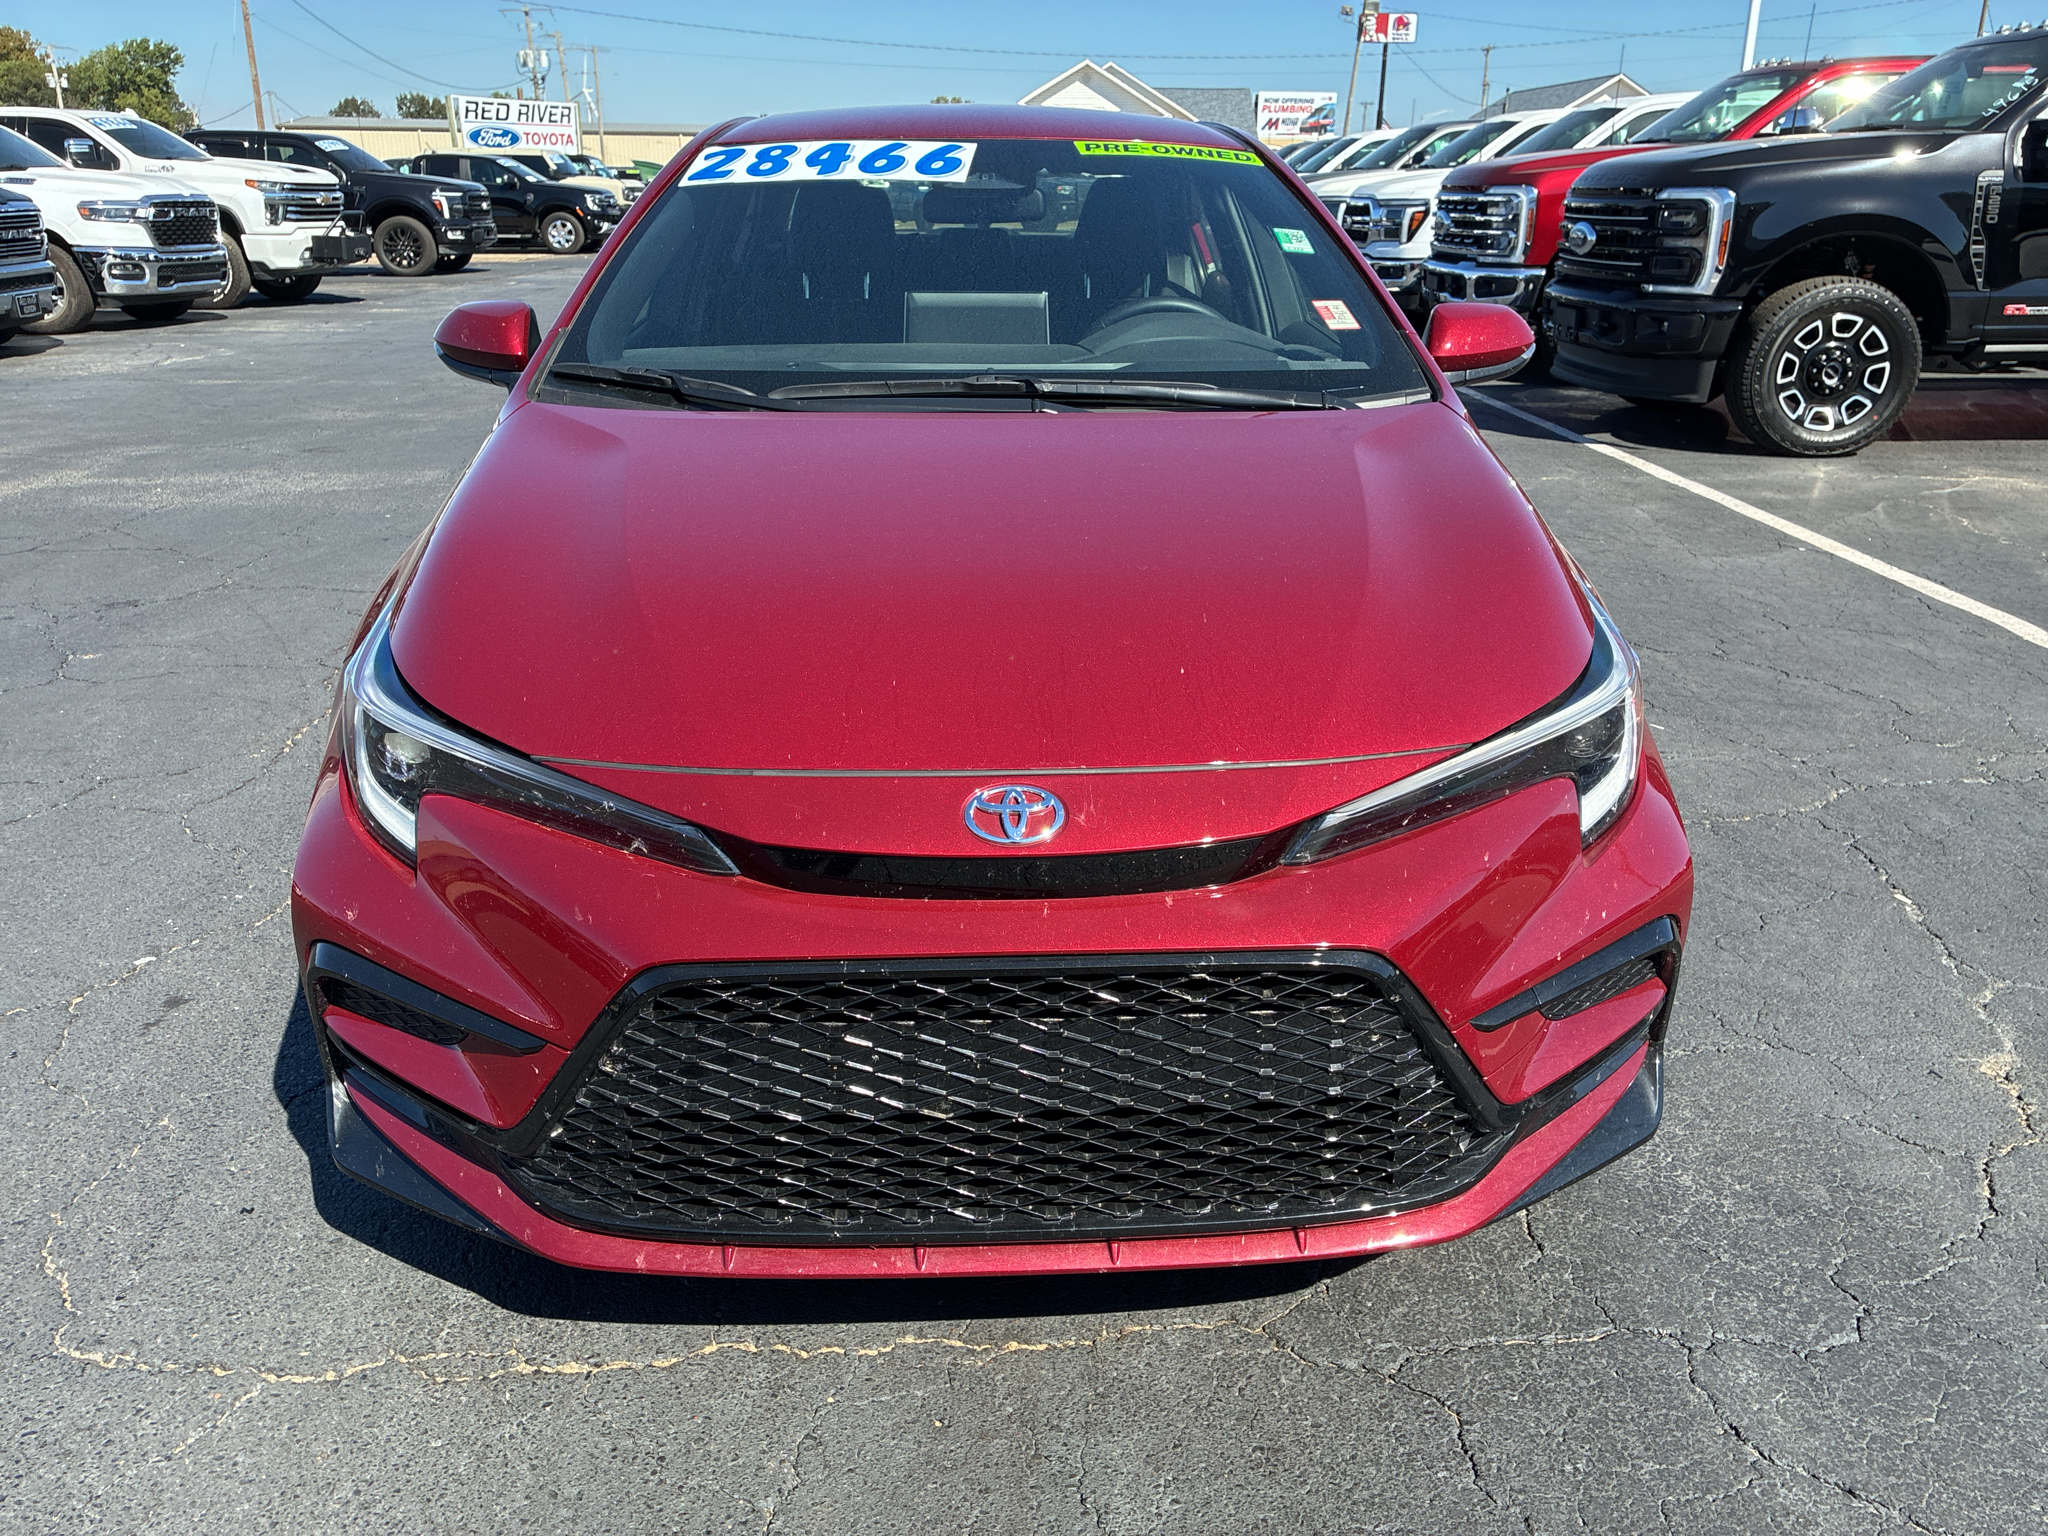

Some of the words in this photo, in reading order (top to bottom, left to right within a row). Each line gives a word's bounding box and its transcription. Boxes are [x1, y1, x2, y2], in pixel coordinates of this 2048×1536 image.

[464, 100, 510, 121] RED
[517, 103, 571, 124] RIVER
[1261, 104, 1313, 114] PLUMBING
[477, 127, 512, 147] Ford
[523, 131, 574, 146] TOYOTA
[687, 142, 966, 182] 28466
[1085, 143, 1256, 162] PRE-OWNED
